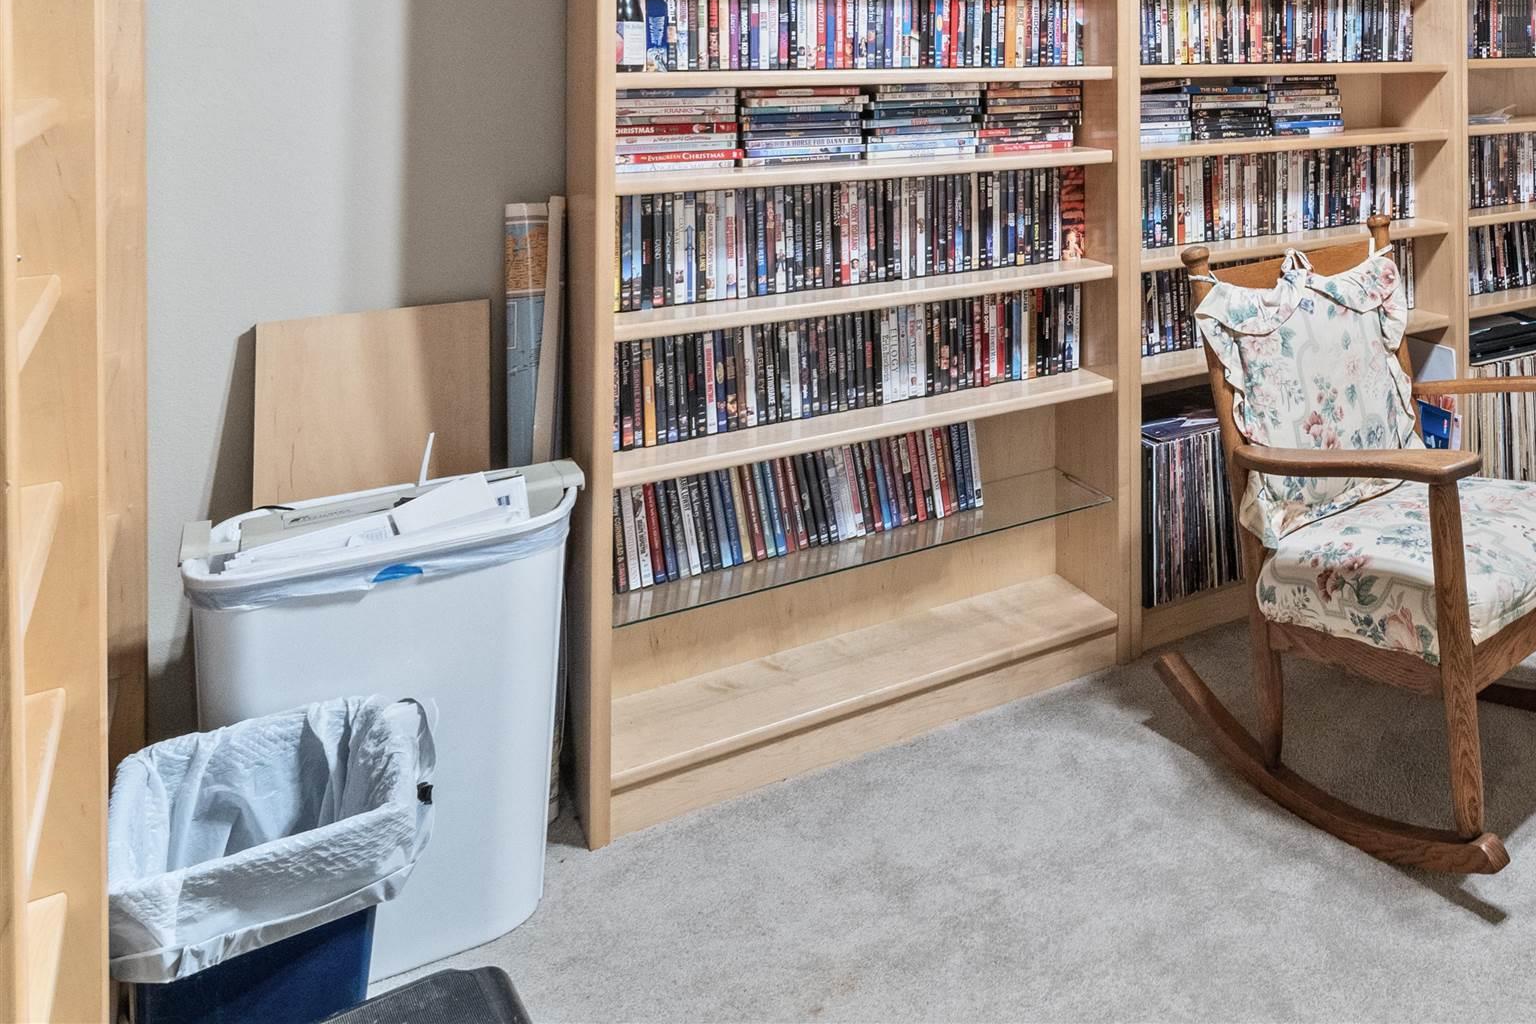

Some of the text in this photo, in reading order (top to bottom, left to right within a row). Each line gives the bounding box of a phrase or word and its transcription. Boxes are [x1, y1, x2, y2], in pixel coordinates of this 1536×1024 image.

[846, 4, 854, 20] ENEMY
[846, 22, 854, 38] LINES
[647, 152, 725, 162] EVERGREEN CHRISTMAS
[814, 236, 822, 250] AIR
[891, 328, 899, 372] EULOGY
[614, 517, 624, 556] CORNBREAD
